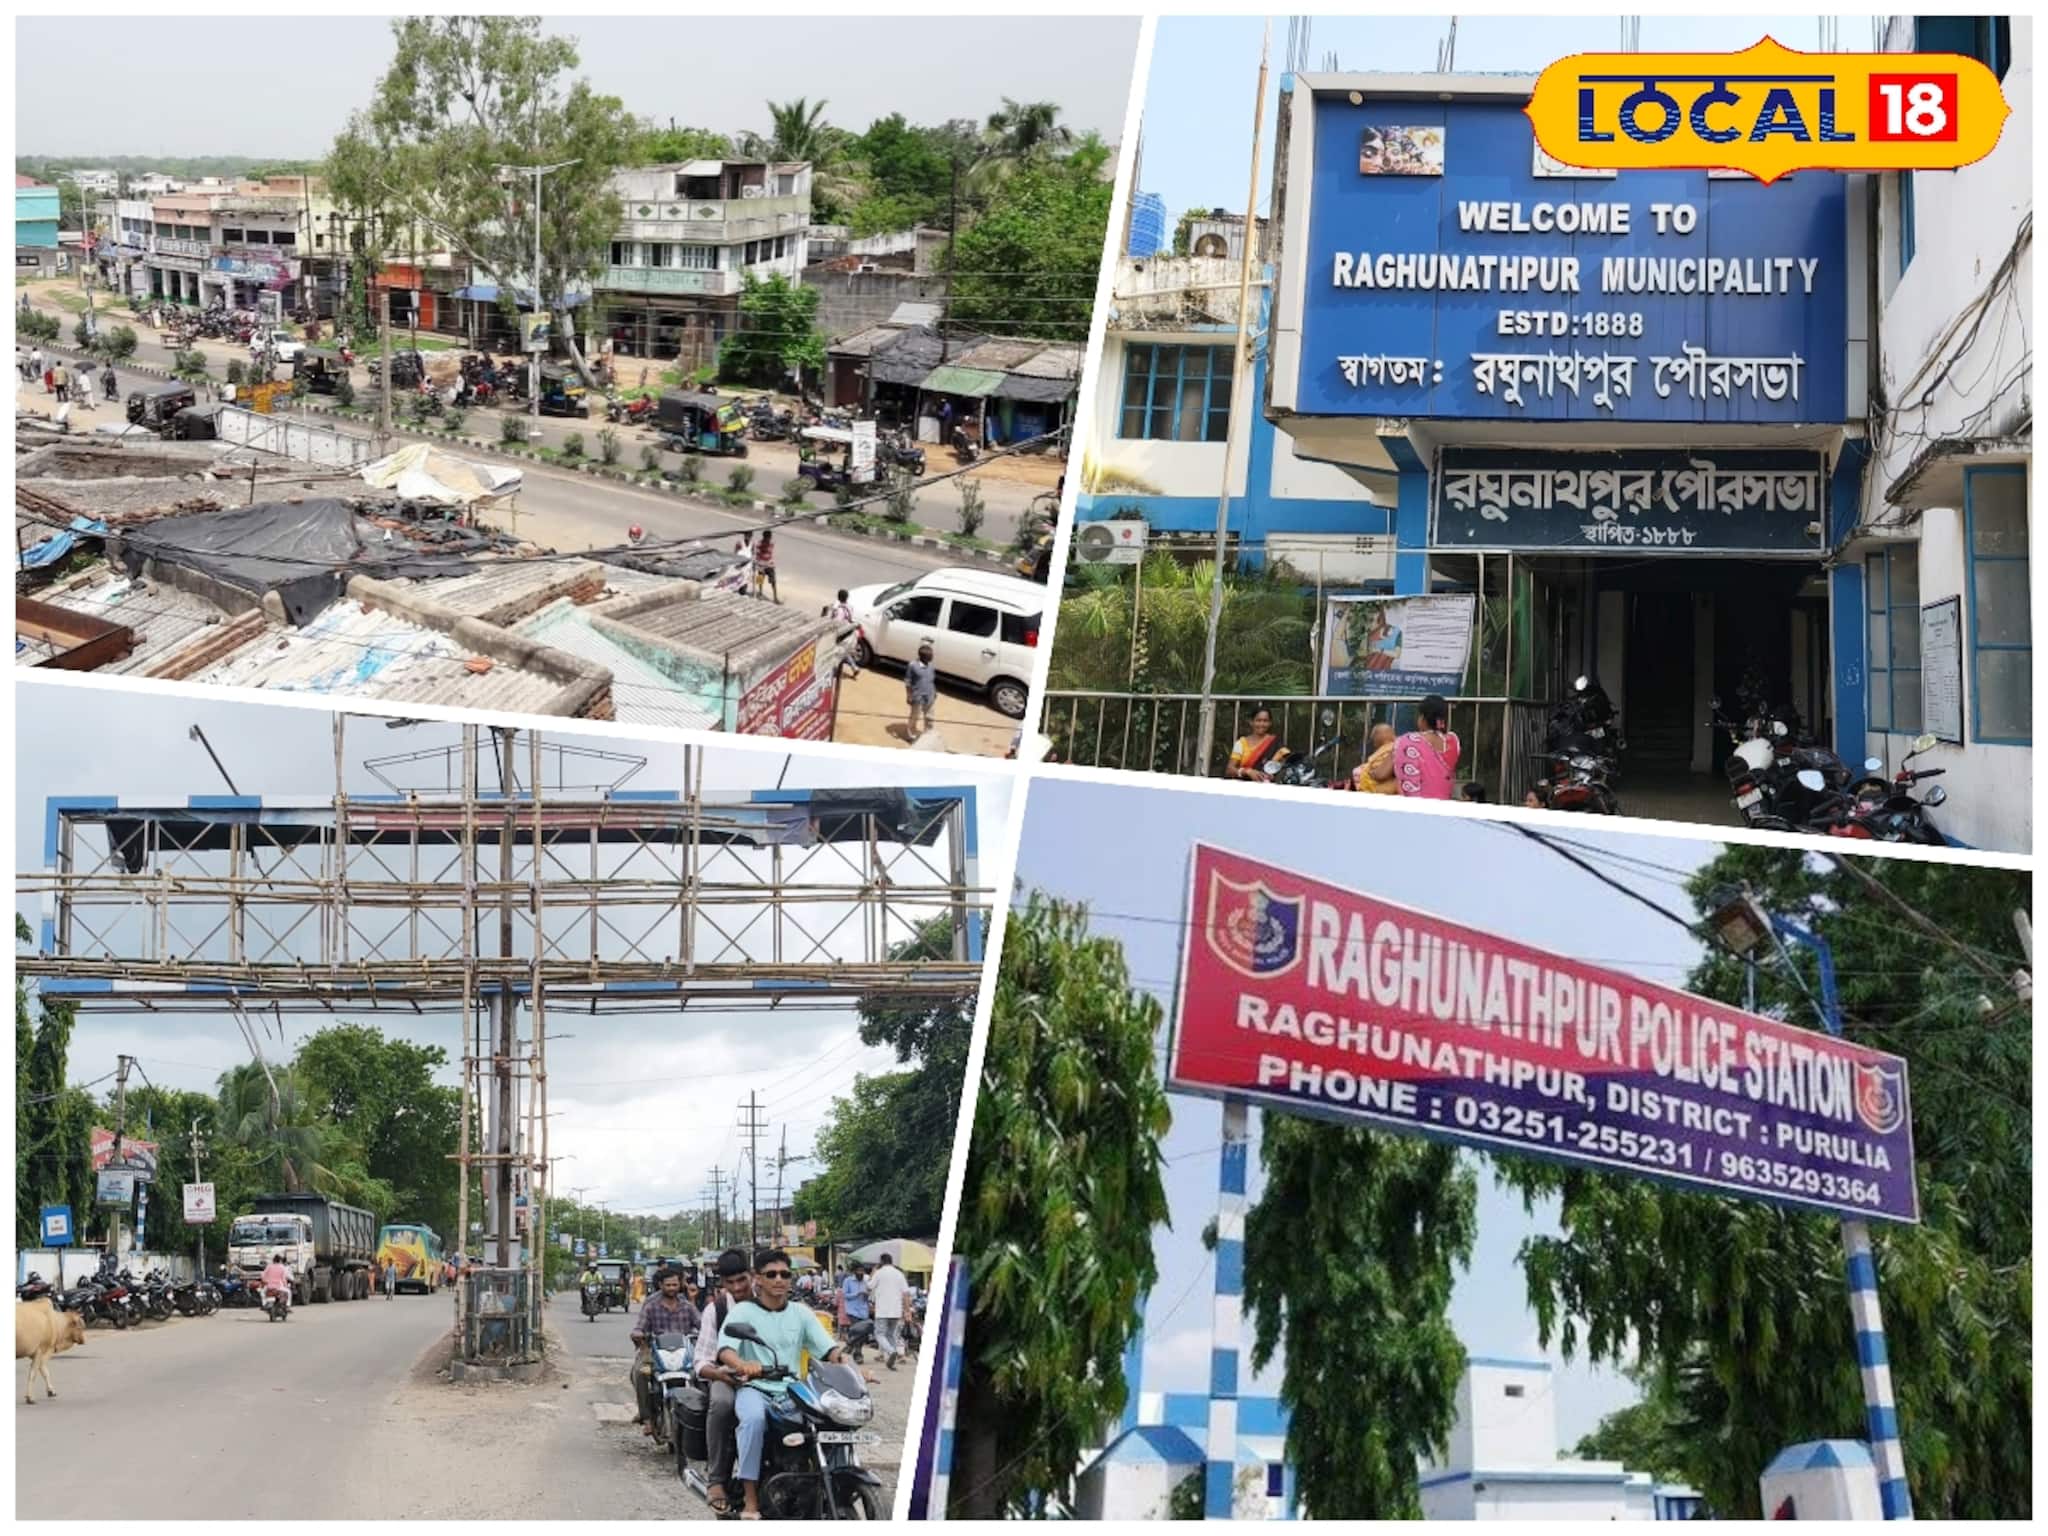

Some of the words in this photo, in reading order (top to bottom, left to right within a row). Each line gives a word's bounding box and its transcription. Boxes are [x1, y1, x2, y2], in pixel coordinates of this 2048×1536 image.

[1458, 201, 1631, 235] WELCOME
[1651, 203, 1698, 234] TO
[1333, 252, 1580, 293] RAGHUNATHPUR
[1601, 256, 1819, 294] MUNICIPALITY
[1497, 310, 1644, 337] ESTD:1888
[1470, 348, 1639, 411] রঘুনাথপুর
[1648, 339, 1806, 401] পৌরসভা
[1445, 469, 1653, 523] রঘুনাথপুর
[1659, 459, 1820, 515] পৌরসভা
[1307, 900, 1624, 1064] RAGHUNATHPUR
[1629, 995, 1740, 1096] POLICE
[1744, 1029, 1853, 1123] STATION
[1236, 992, 1597, 1112] RAGHUNATHPUR,
[1606, 1081, 1752, 1140] DISTRICT
[1775, 1121, 1892, 1172] PURULIA
[1257, 1053, 1419, 1115] PHONE
[1454, 1095, 1693, 1169] 03251-255231
[1720, 1151, 1882, 1206] 9635293364
